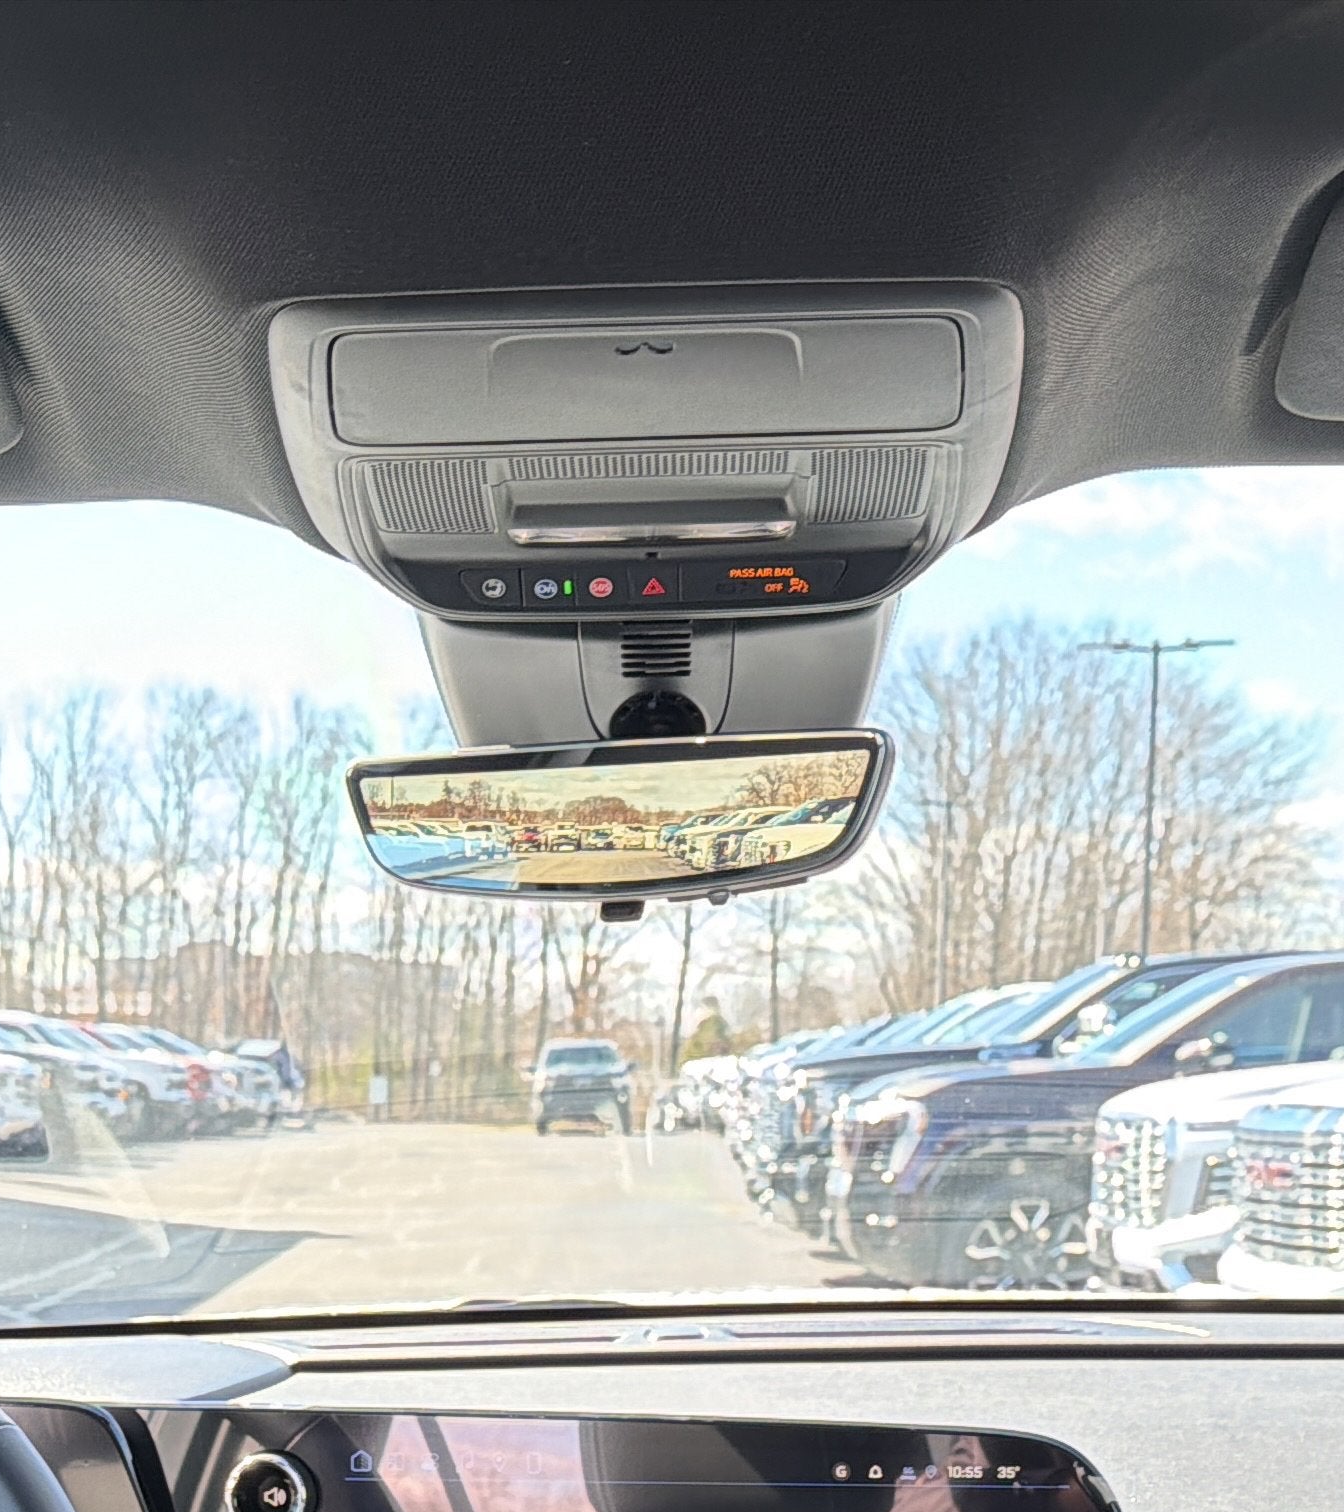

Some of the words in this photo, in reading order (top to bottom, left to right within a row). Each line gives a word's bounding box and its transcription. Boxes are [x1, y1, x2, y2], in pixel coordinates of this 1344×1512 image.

[729, 568, 755, 578] PASS
[756, 567, 773, 578] AIR
[774, 567, 794, 577] BAG
[764, 582, 784, 593] OFF
[947, 1465, 984, 1479] 10:55
